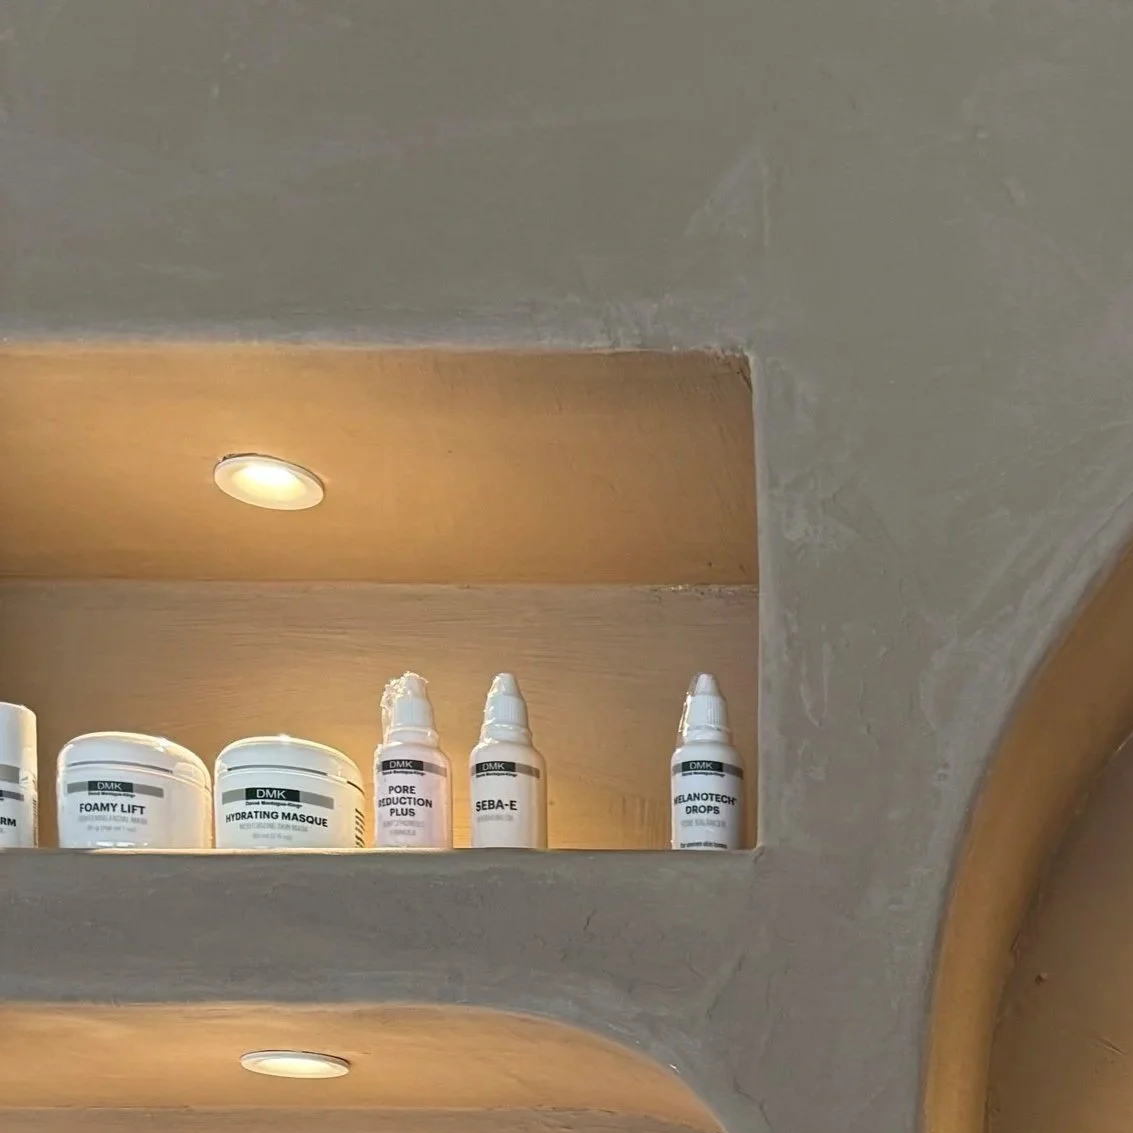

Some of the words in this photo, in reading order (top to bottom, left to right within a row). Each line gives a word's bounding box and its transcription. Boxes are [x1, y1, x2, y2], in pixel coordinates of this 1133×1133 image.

[389, 761, 413, 769] DMK
[482, 762, 505, 771] DMK
[689, 762, 713, 770] DMK
[97, 782, 122, 790] DMK
[388, 785, 416, 794] PORE
[256, 788, 287, 799] DMK
[80, 803, 118, 813] FOAMY
[121, 804, 145, 815] LIFT
[475, 799, 518, 812] SEBA-E
[685, 805, 720, 814] DROPS
[389, 808, 416, 817] PLUS
[226, 811, 279, 823] HYDRATING
[281, 811, 329, 827] MASQUE
